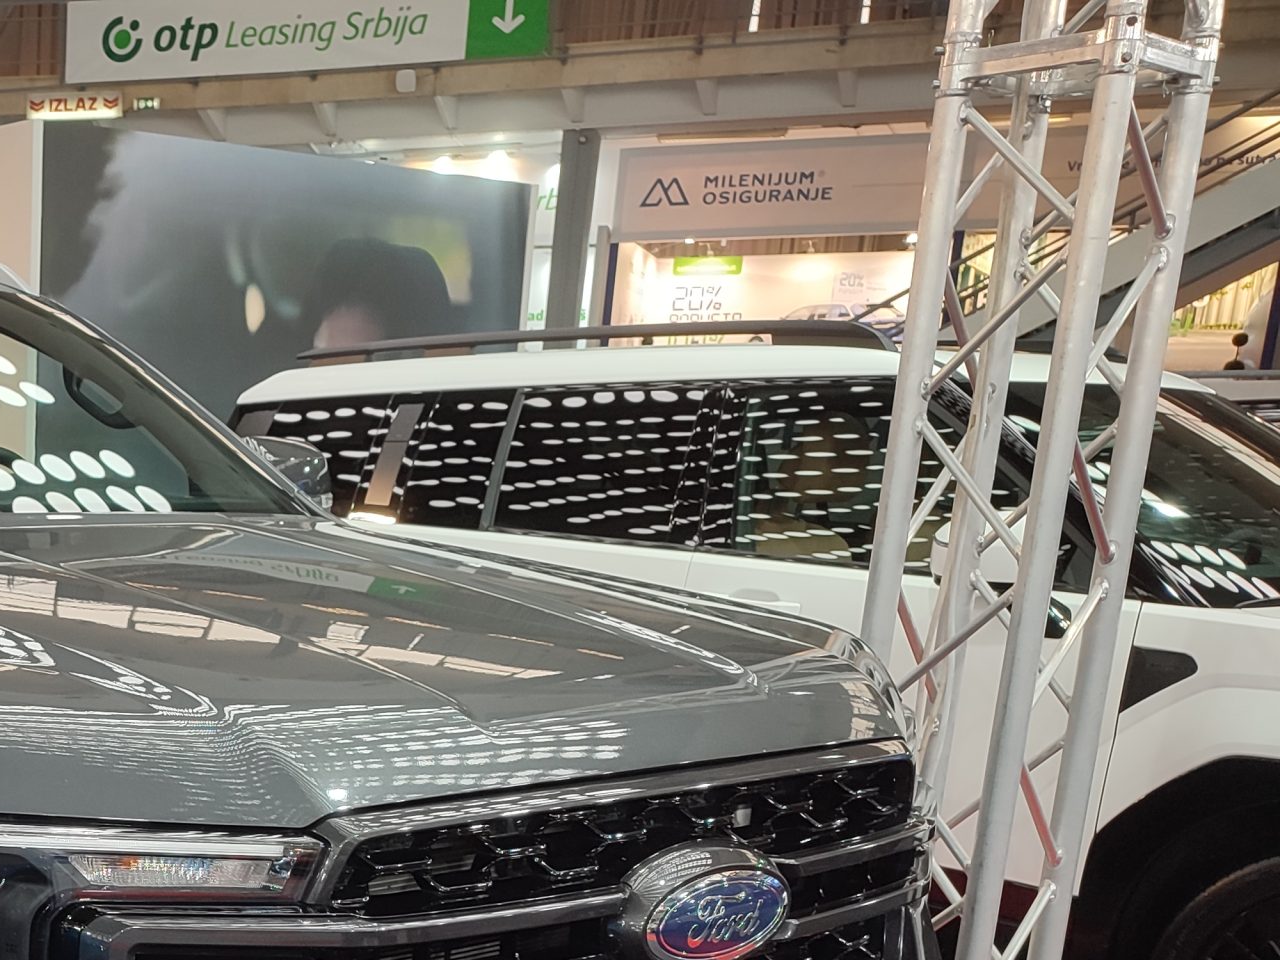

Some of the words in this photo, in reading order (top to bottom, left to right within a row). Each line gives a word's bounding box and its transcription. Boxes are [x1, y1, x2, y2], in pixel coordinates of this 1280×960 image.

[153, 16, 219, 62] otp
[225, 15, 336, 51] Leasing
[342, 6, 428, 46] Srbija
[49, 97, 98, 113] IZLAZ
[704, 171, 815, 188] MILENIJUM
[702, 186, 833, 205] OSIGURANJE
[686, 892, 762, 949] Ford
